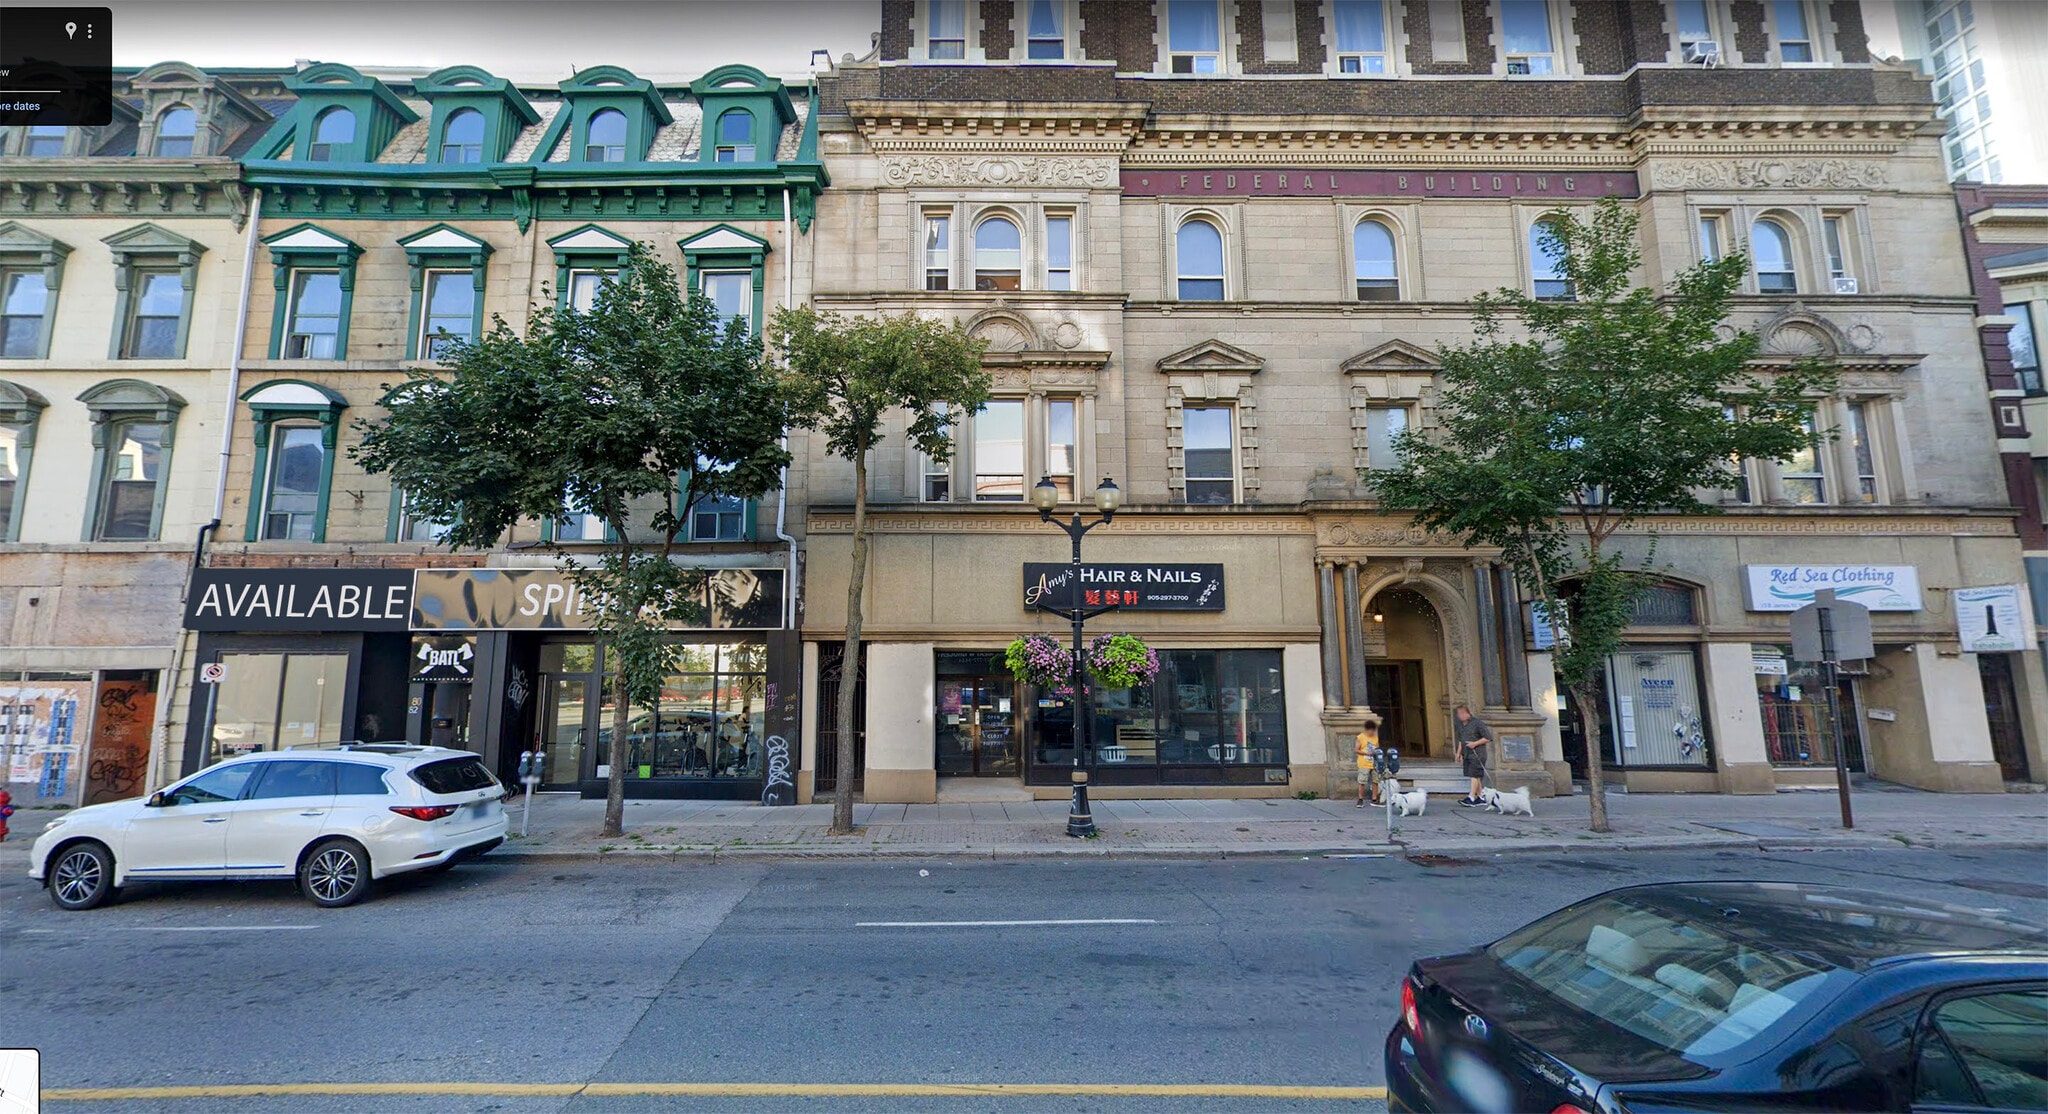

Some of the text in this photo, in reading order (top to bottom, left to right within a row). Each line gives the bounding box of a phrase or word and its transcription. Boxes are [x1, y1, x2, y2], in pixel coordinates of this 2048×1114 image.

[1180, 174, 1575, 191] FEDERAL BUILDING
[1770, 567, 1895, 585] Red Sea Clothing
[1025, 568, 1202, 605] Amy's HAIR & NAILS
[195, 583, 407, 619] AVAILABLE
[429, 649, 460, 666] BATL
[411, 697, 422, 706] 80
